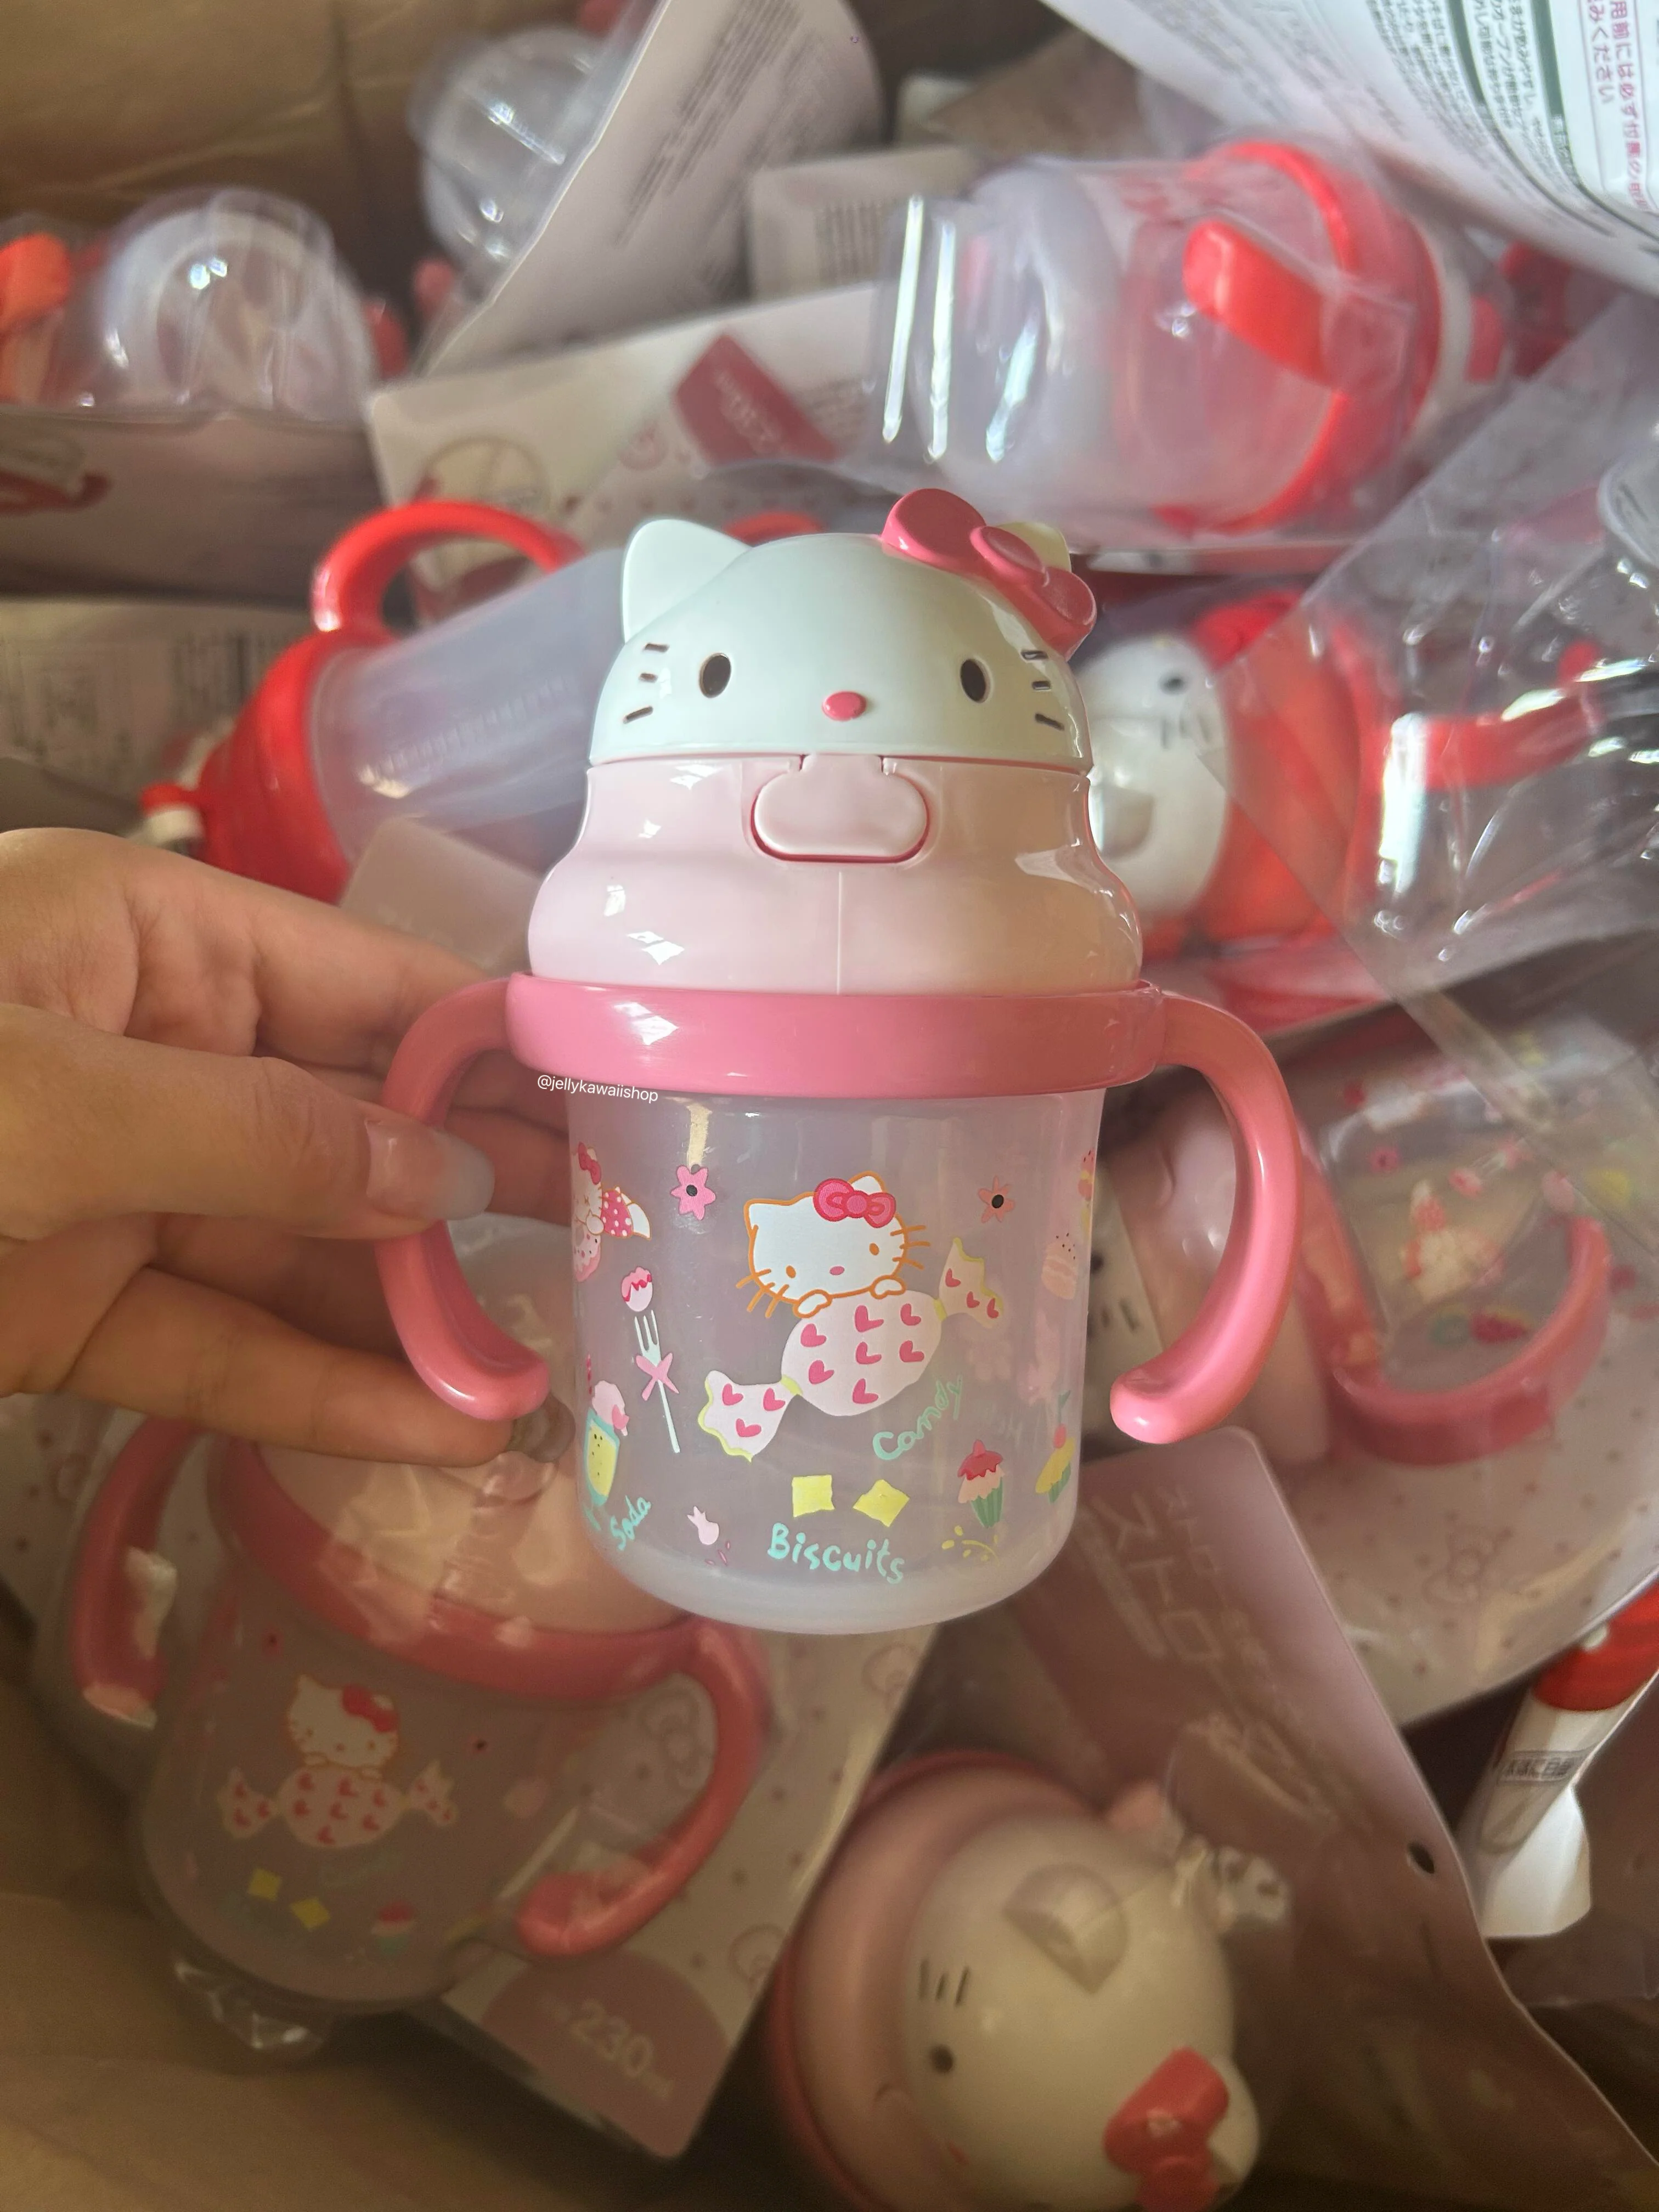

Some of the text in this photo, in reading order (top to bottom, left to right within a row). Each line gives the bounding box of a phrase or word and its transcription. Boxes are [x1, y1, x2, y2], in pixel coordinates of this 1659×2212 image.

[1588, 0, 1615, 105] みください
[872, 1375, 963, 1460] Candy
[610, 1495, 651, 1551] Soda
[768, 1522, 905, 1584] Biscuits
